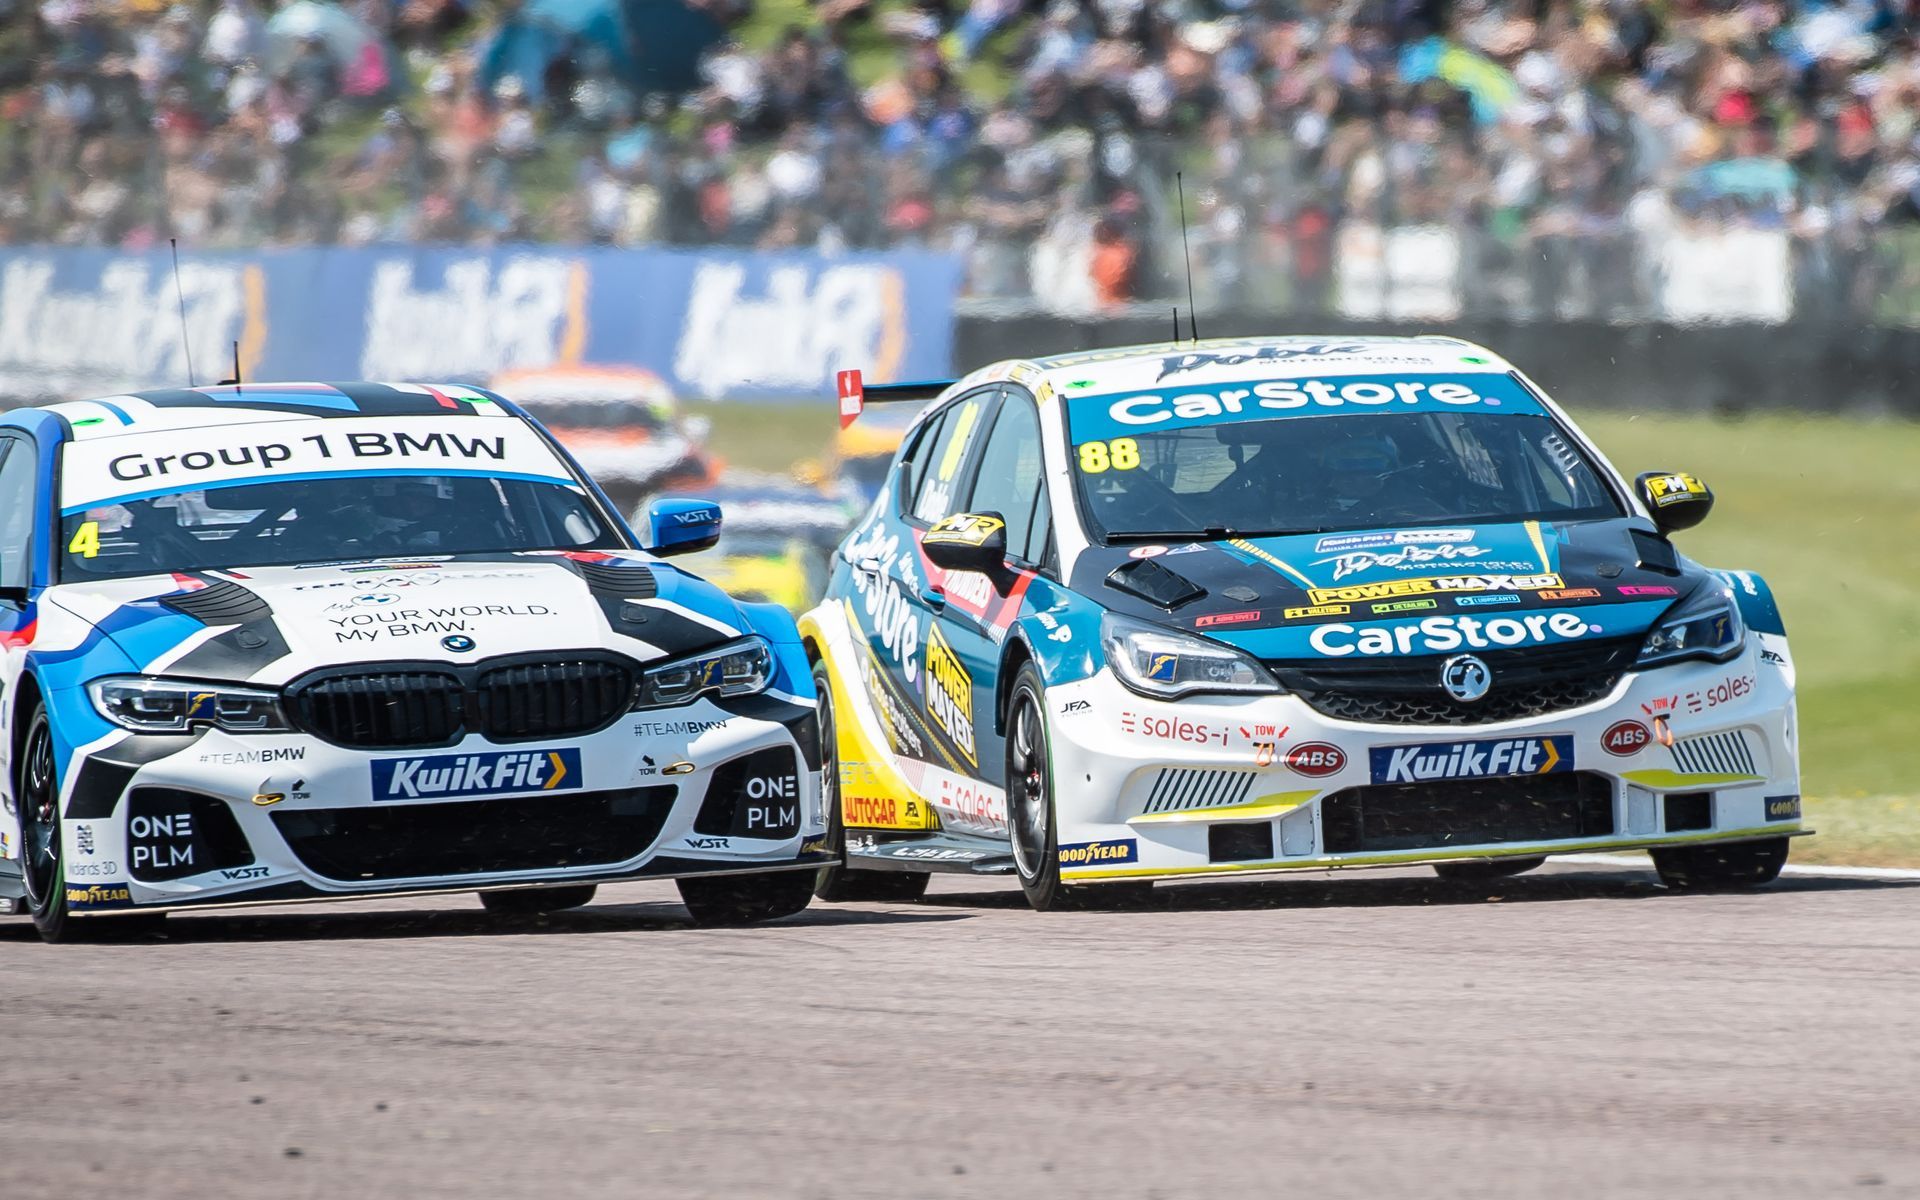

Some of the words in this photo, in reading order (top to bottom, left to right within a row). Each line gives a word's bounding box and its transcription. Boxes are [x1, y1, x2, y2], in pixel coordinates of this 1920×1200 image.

[109, 443, 292, 481] Group
[303, 437, 331, 460] 1
[352, 432, 505, 461] BMW
[1079, 437, 1140, 474] 88
[674, 511, 711, 523] WSR
[69, 521, 100, 559] 4
[1315, 580, 1434, 601] POWER
[1437, 575, 1555, 591] MAXED
[329, 609, 423, 628] YOUR
[428, 605, 558, 618] WORLD.
[335, 629, 378, 643] My
[387, 620, 475, 637] BMW.
[1760, 649, 1785, 663] JFA
[927, 640, 971, 718] POWER
[928, 671, 974, 755] MAXED
[1060, 700, 1091, 713] JFA
[1652, 698, 1669, 709] TOW
[634, 719, 727, 737] #TEAMBMW
[1143, 716, 1230, 747] sales-i
[1254, 725, 1276, 736] TOW
[1610, 730, 1645, 747] ABS
[199, 746, 306, 766] #TEAMBMW
[1296, 751, 1338, 767] ABS
[746, 775, 796, 799] ONE
[748, 804, 795, 830] PLM
[845, 798, 897, 825] AUTOCAR
[130, 813, 193, 839] ONE
[685, 838, 730, 849] WSR
[102, 861, 118, 875] 3D
[134, 844, 194, 869] PLM
[220, 866, 270, 880] WSR
